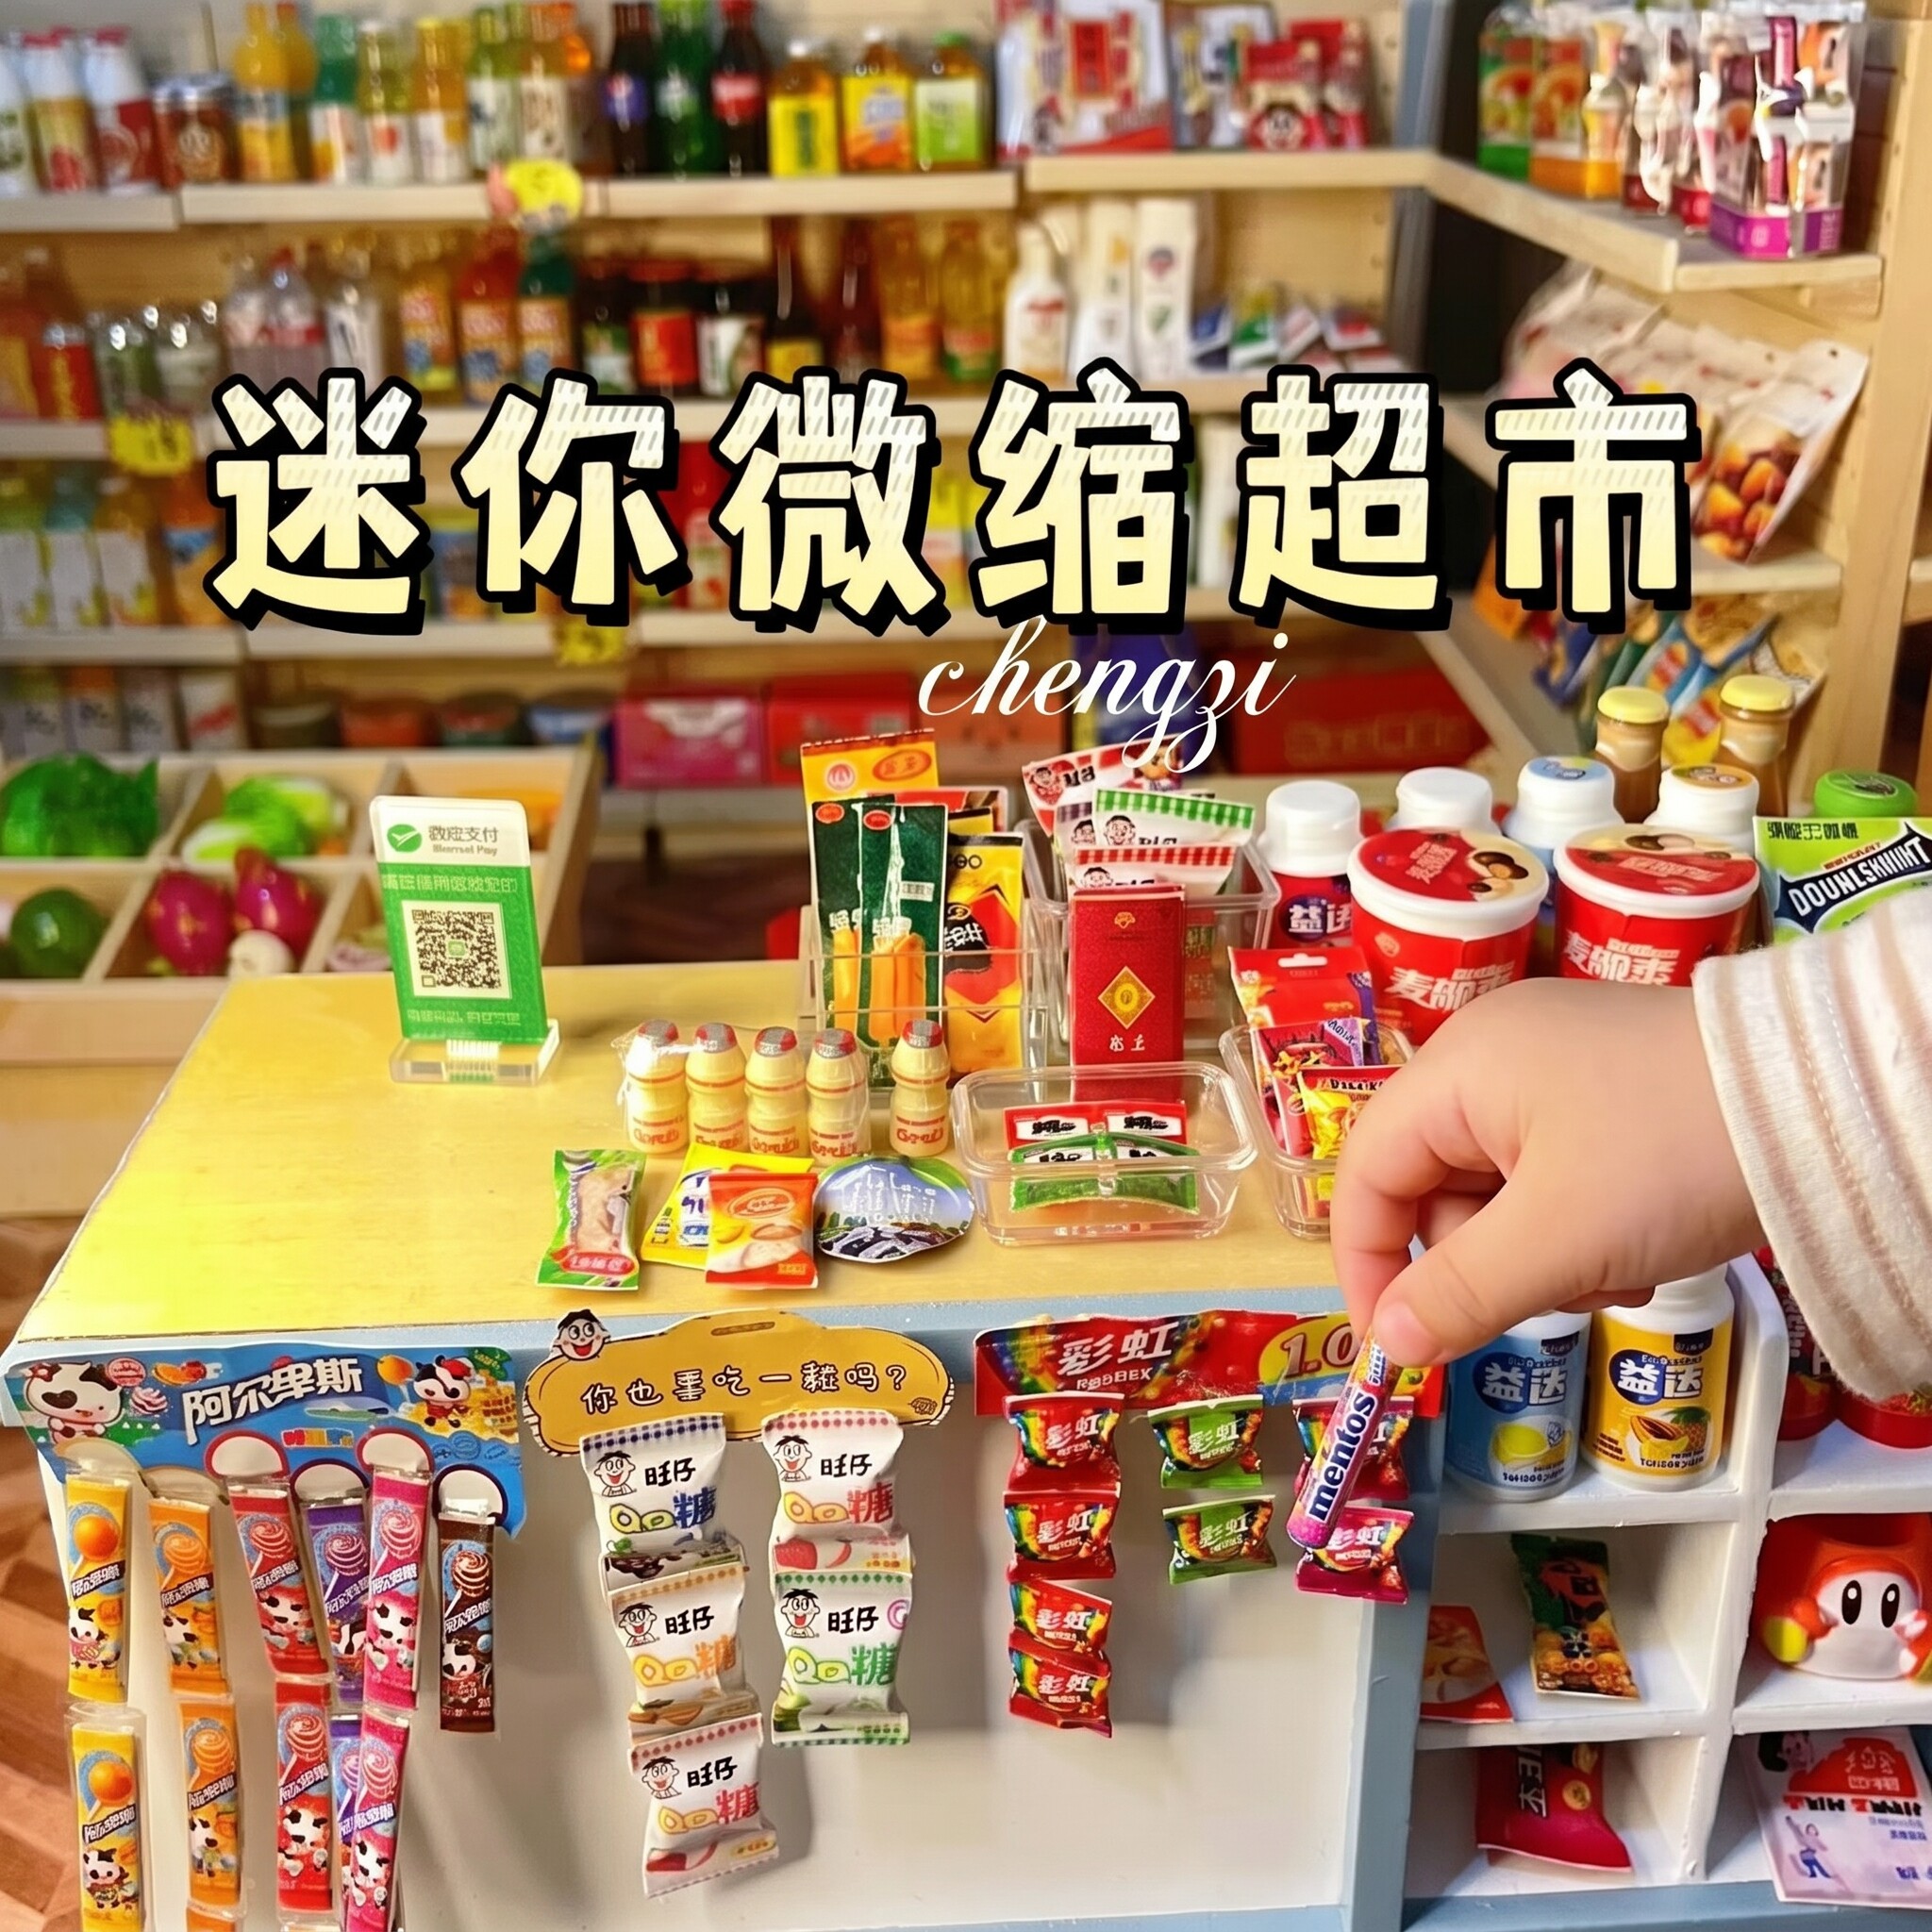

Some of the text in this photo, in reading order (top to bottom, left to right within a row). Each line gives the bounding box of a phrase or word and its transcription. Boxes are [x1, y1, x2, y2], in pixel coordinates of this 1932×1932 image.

[1057, 1321, 1180, 1376] 彩虹
[1045, 1413, 1104, 1449] 彩虹
[644, 1457, 696, 1487] 旺仔
[820, 1453, 873, 1478] 旺仔
[1306, 1389, 1379, 1524] mentos
[1037, 1508, 1093, 1543] 彩虹
[664, 1605, 715, 1635] 旺仔
[827, 1605, 879, 1633] 旺仔
[687, 1756, 738, 1788] 旺仔
